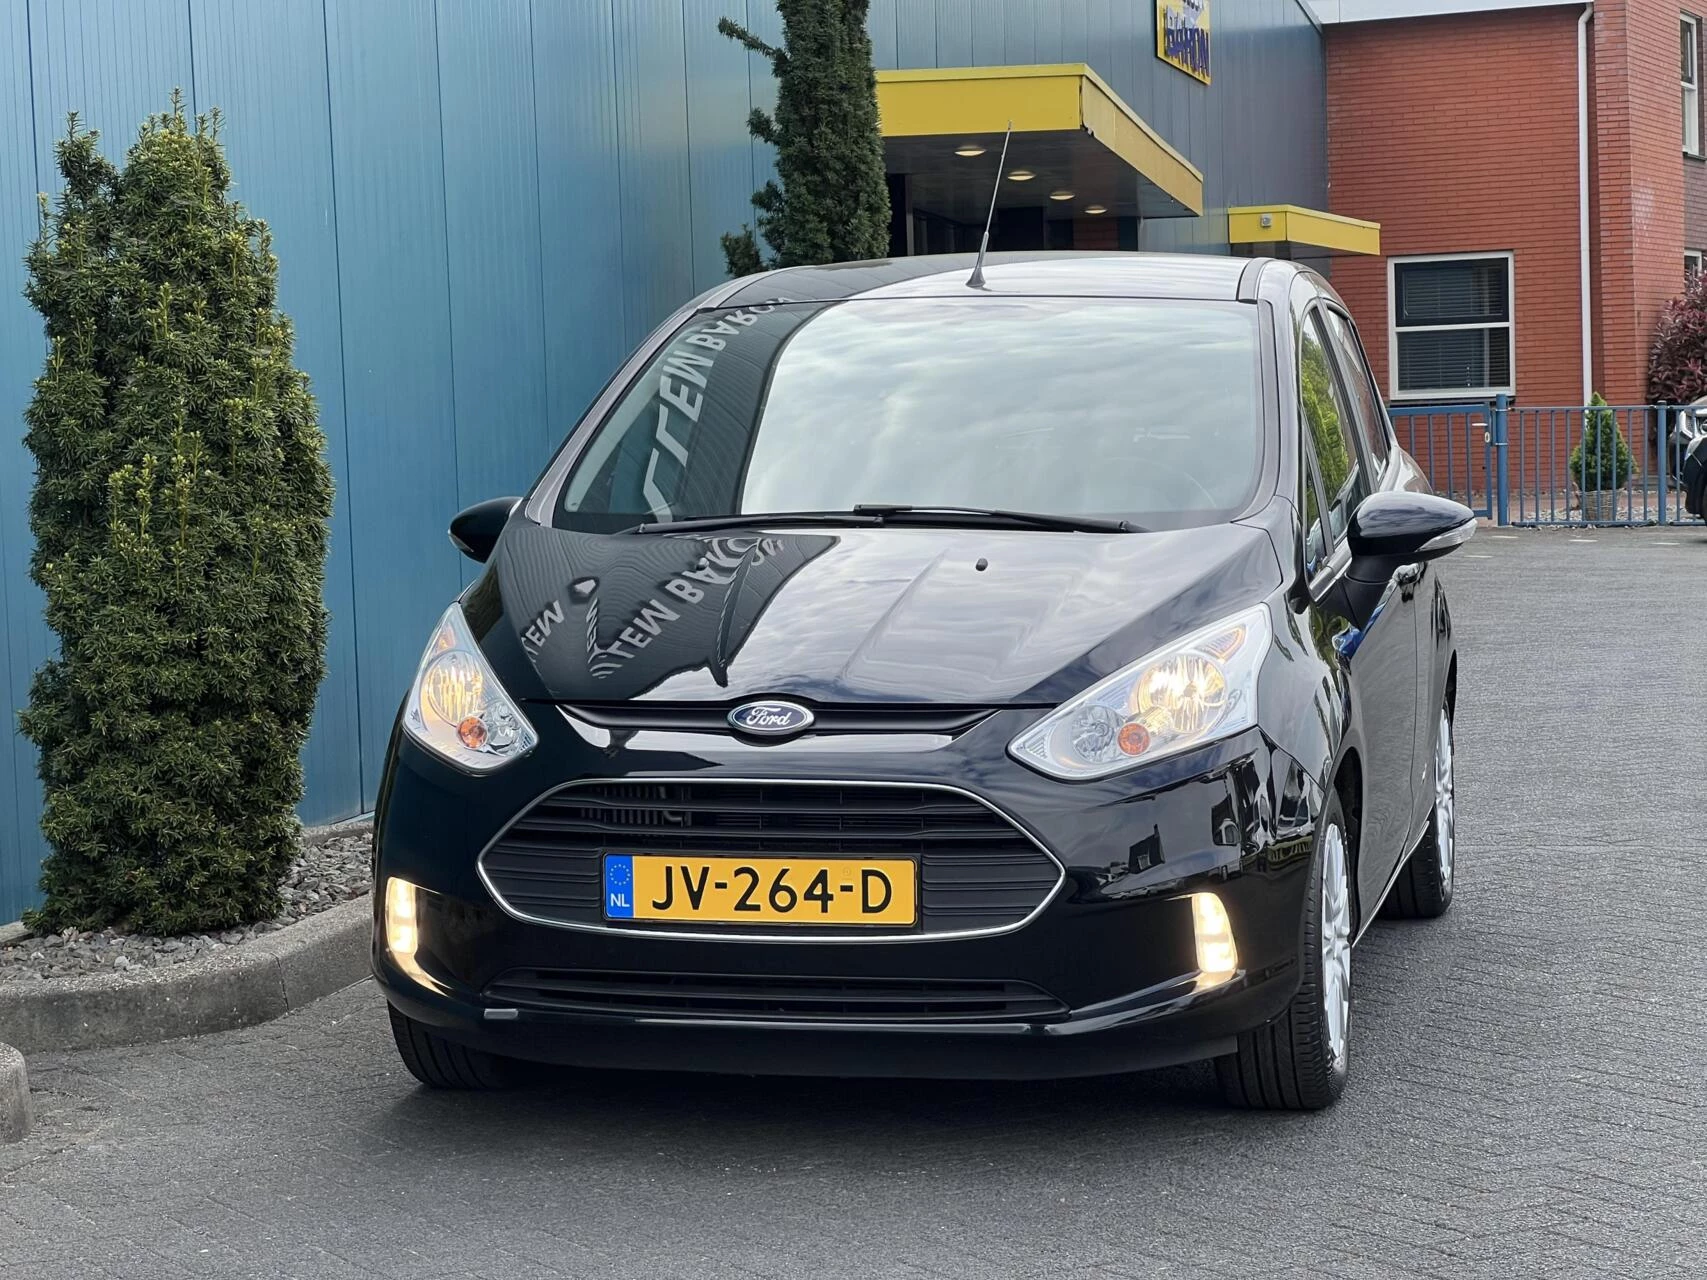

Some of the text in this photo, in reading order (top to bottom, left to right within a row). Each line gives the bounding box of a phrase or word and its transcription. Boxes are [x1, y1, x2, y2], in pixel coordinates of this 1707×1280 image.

[746, 706, 792, 726] Ford
[651, 864, 893, 914] JV-264-D
[610, 892, 631, 908] NL
